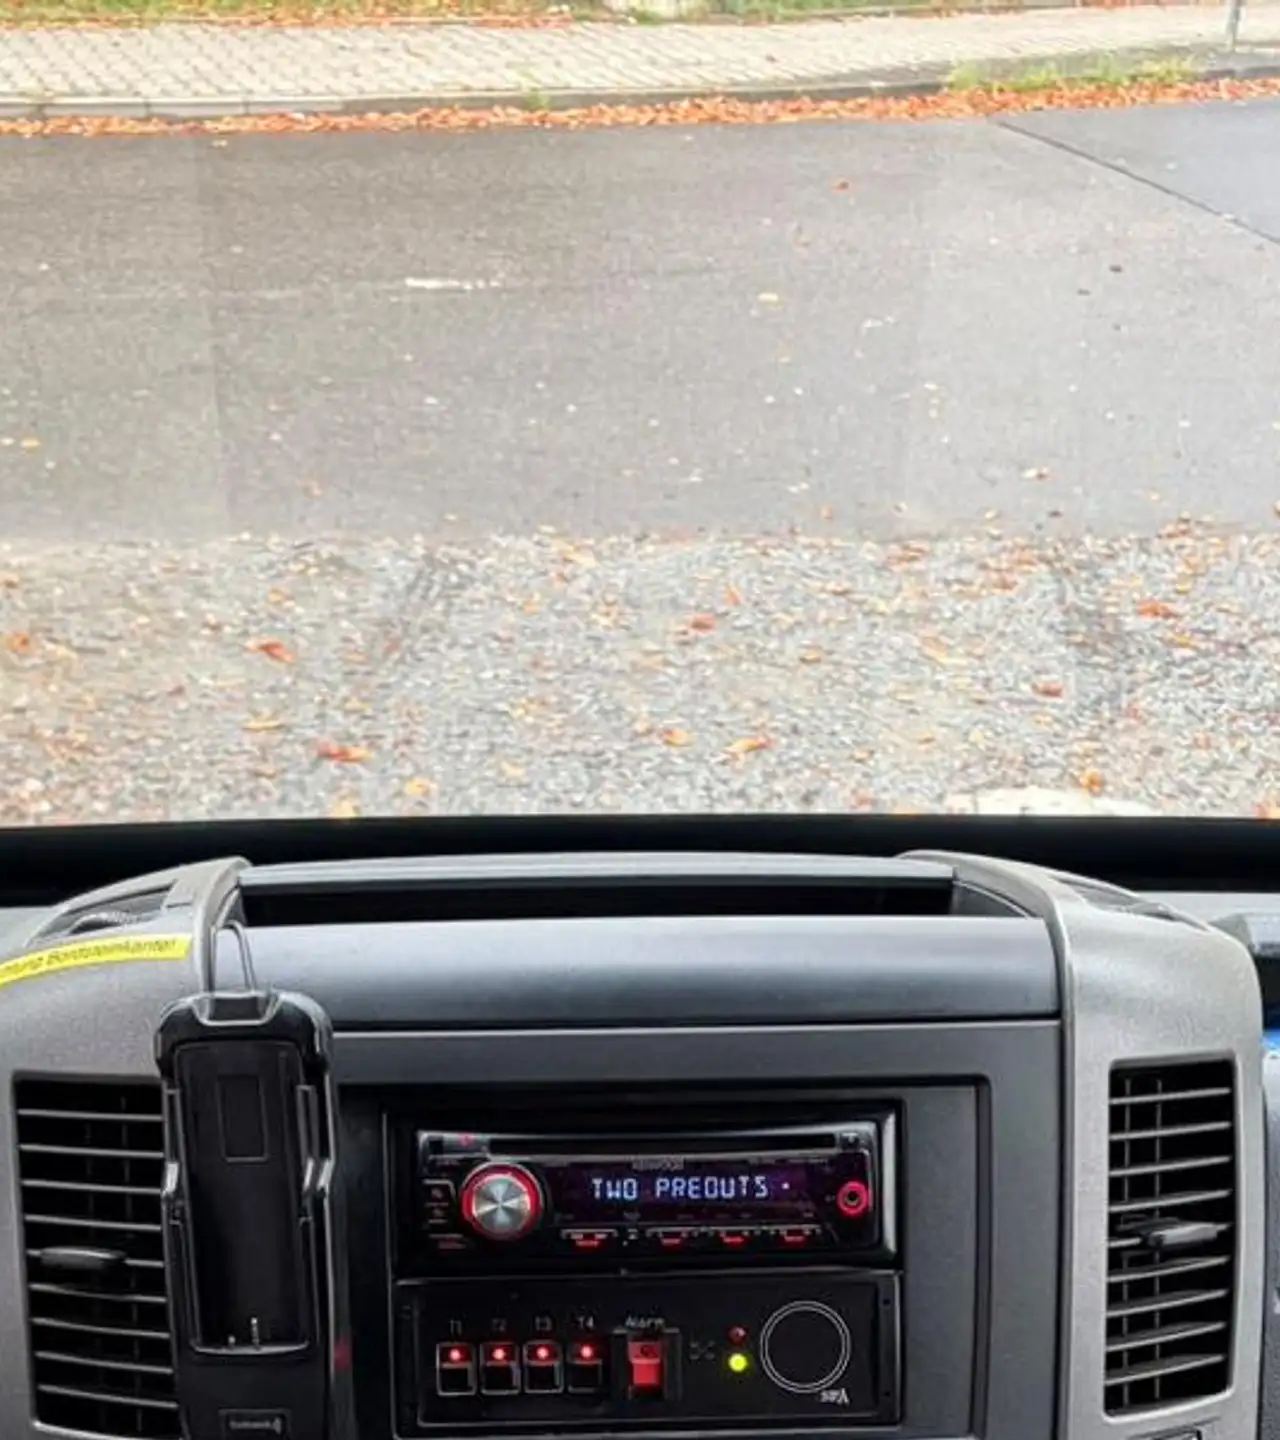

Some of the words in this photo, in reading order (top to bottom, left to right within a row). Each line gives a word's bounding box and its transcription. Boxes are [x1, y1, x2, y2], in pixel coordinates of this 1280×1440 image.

[591, 1178, 638, 1200] TWO
[655, 1176, 769, 1199] PREOUTS
[577, 1316, 595, 1330] T4
